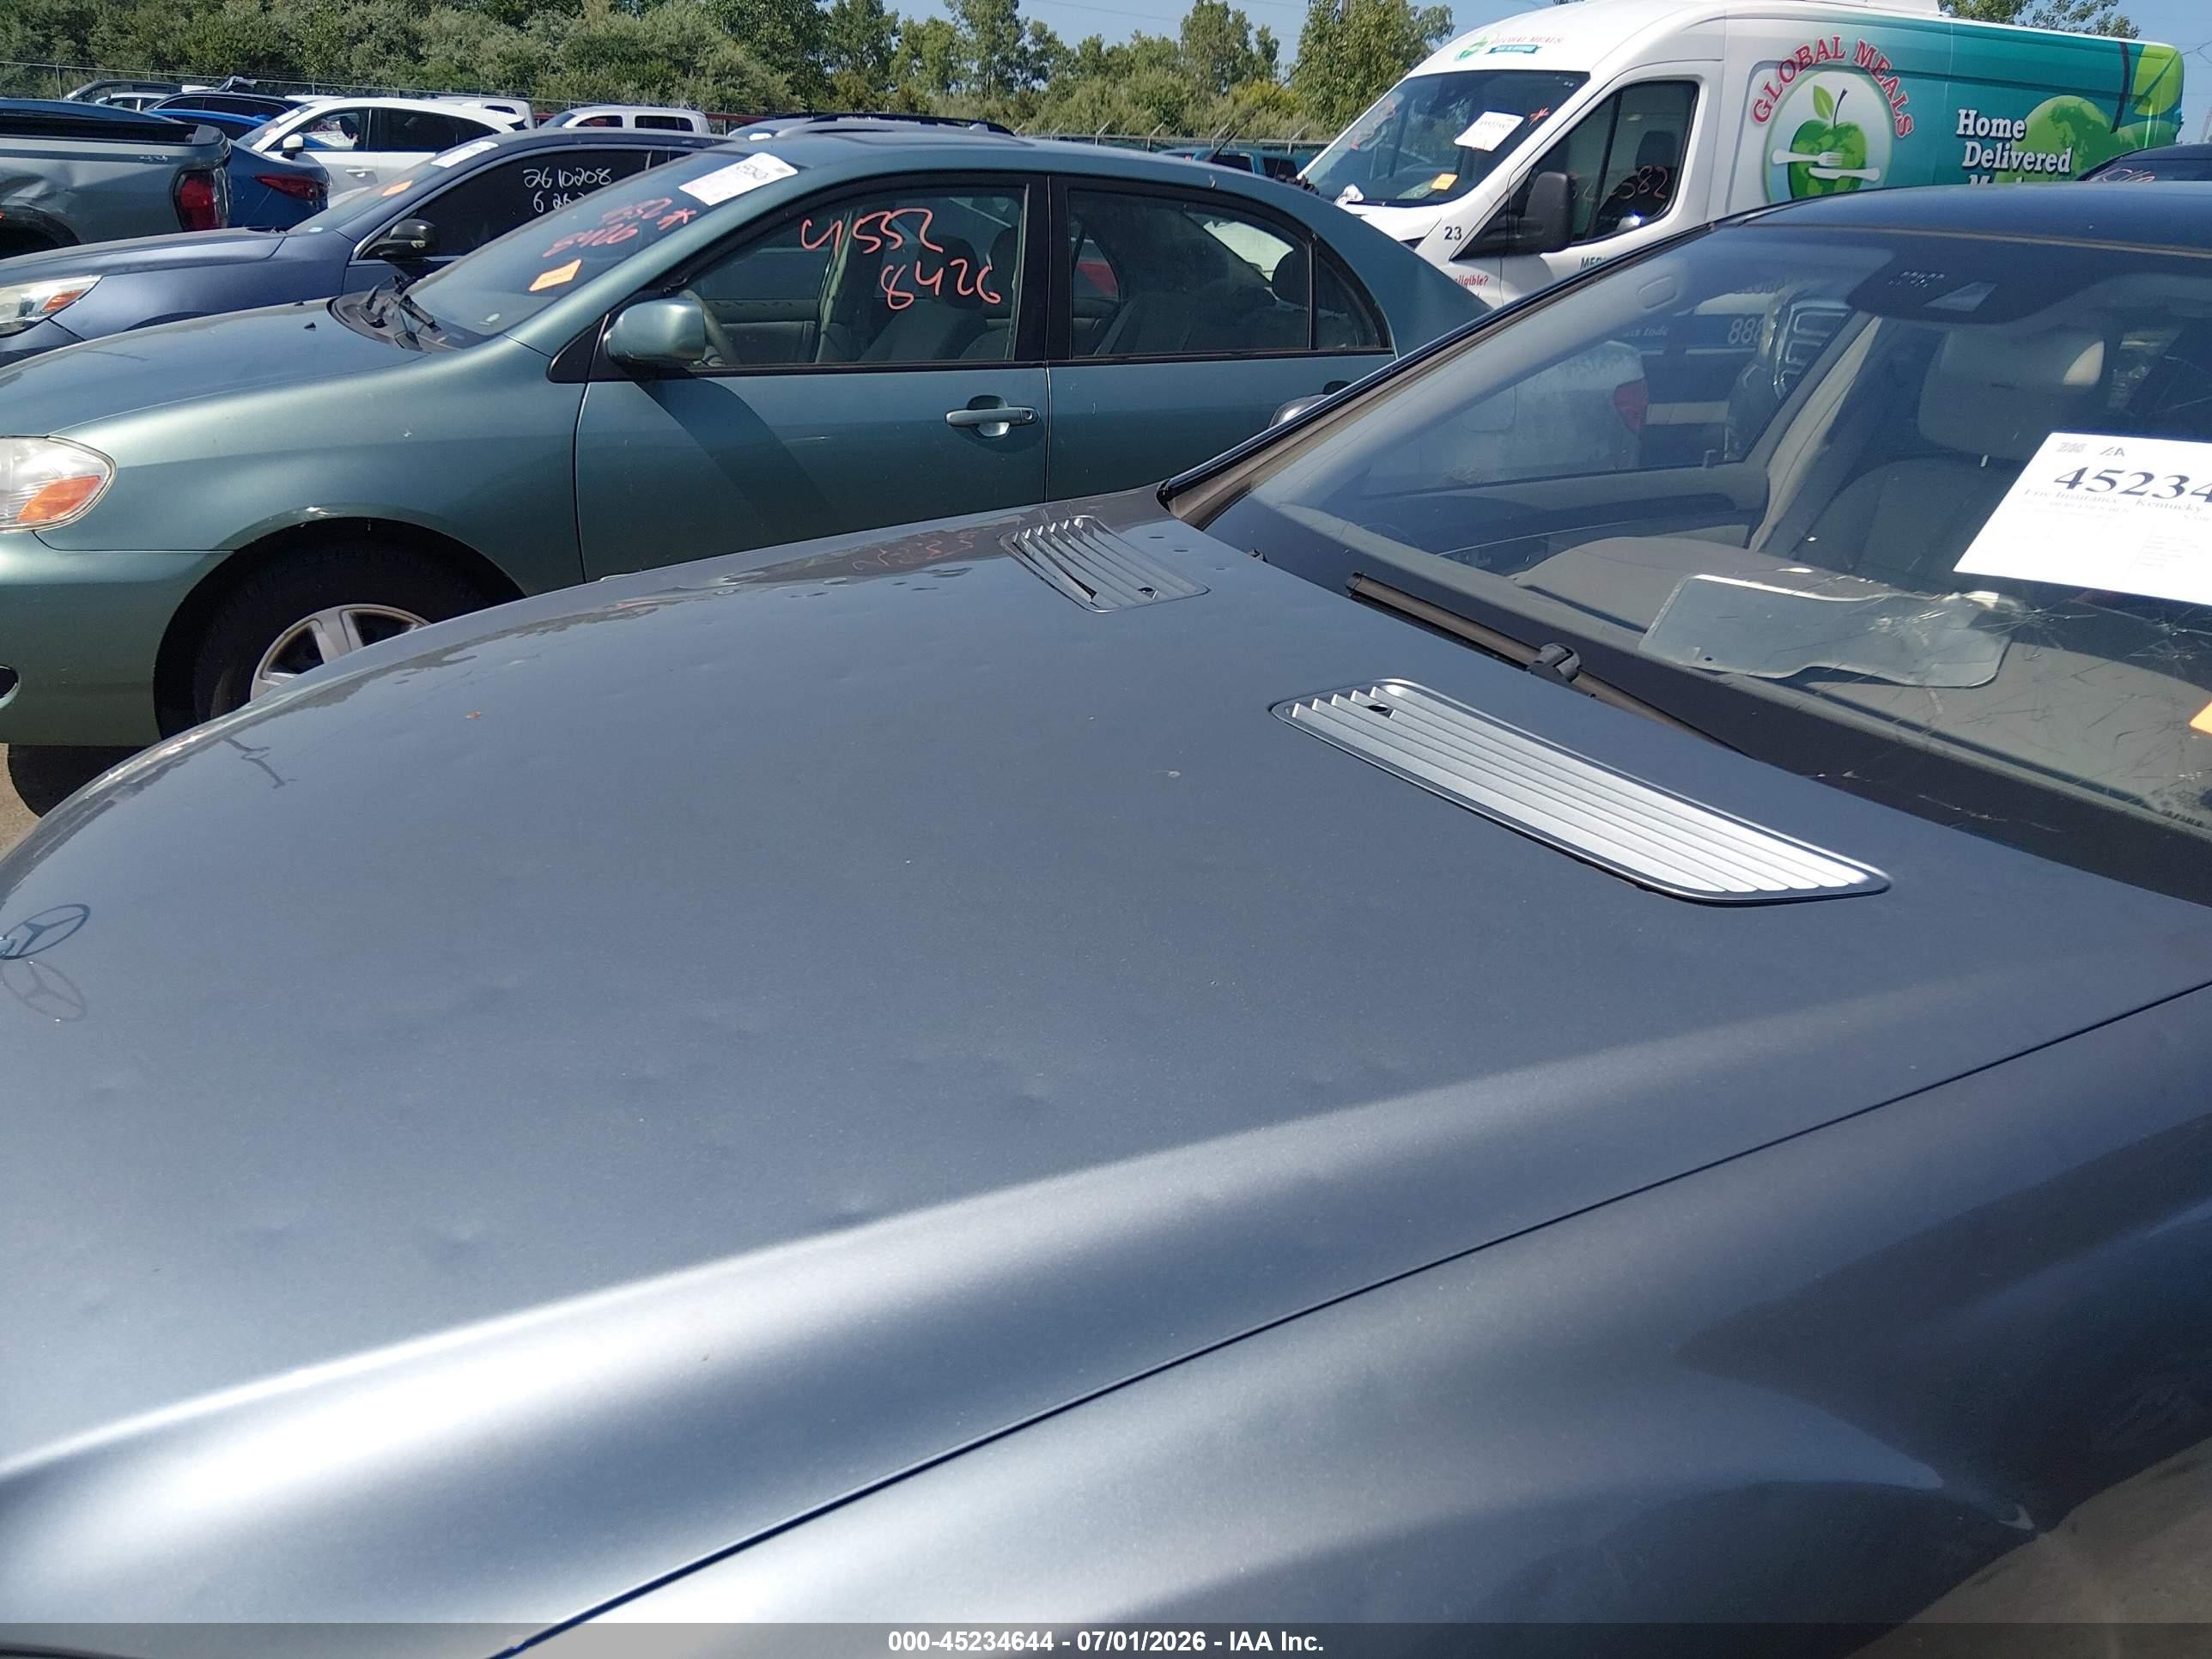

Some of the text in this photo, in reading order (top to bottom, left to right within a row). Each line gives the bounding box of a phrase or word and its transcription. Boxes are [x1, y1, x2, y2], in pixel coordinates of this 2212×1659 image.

[1753, 36, 1914, 137] GLOBAL MEALS
[1957, 109, 2026, 139] Home
[1963, 141, 2071, 173] Delivered
[800, 208, 944, 255] 4552
[1443, 226, 1462, 241] 23
[878, 258, 1001, 310] 8426
[1455, 275, 1489, 288] ligible?
